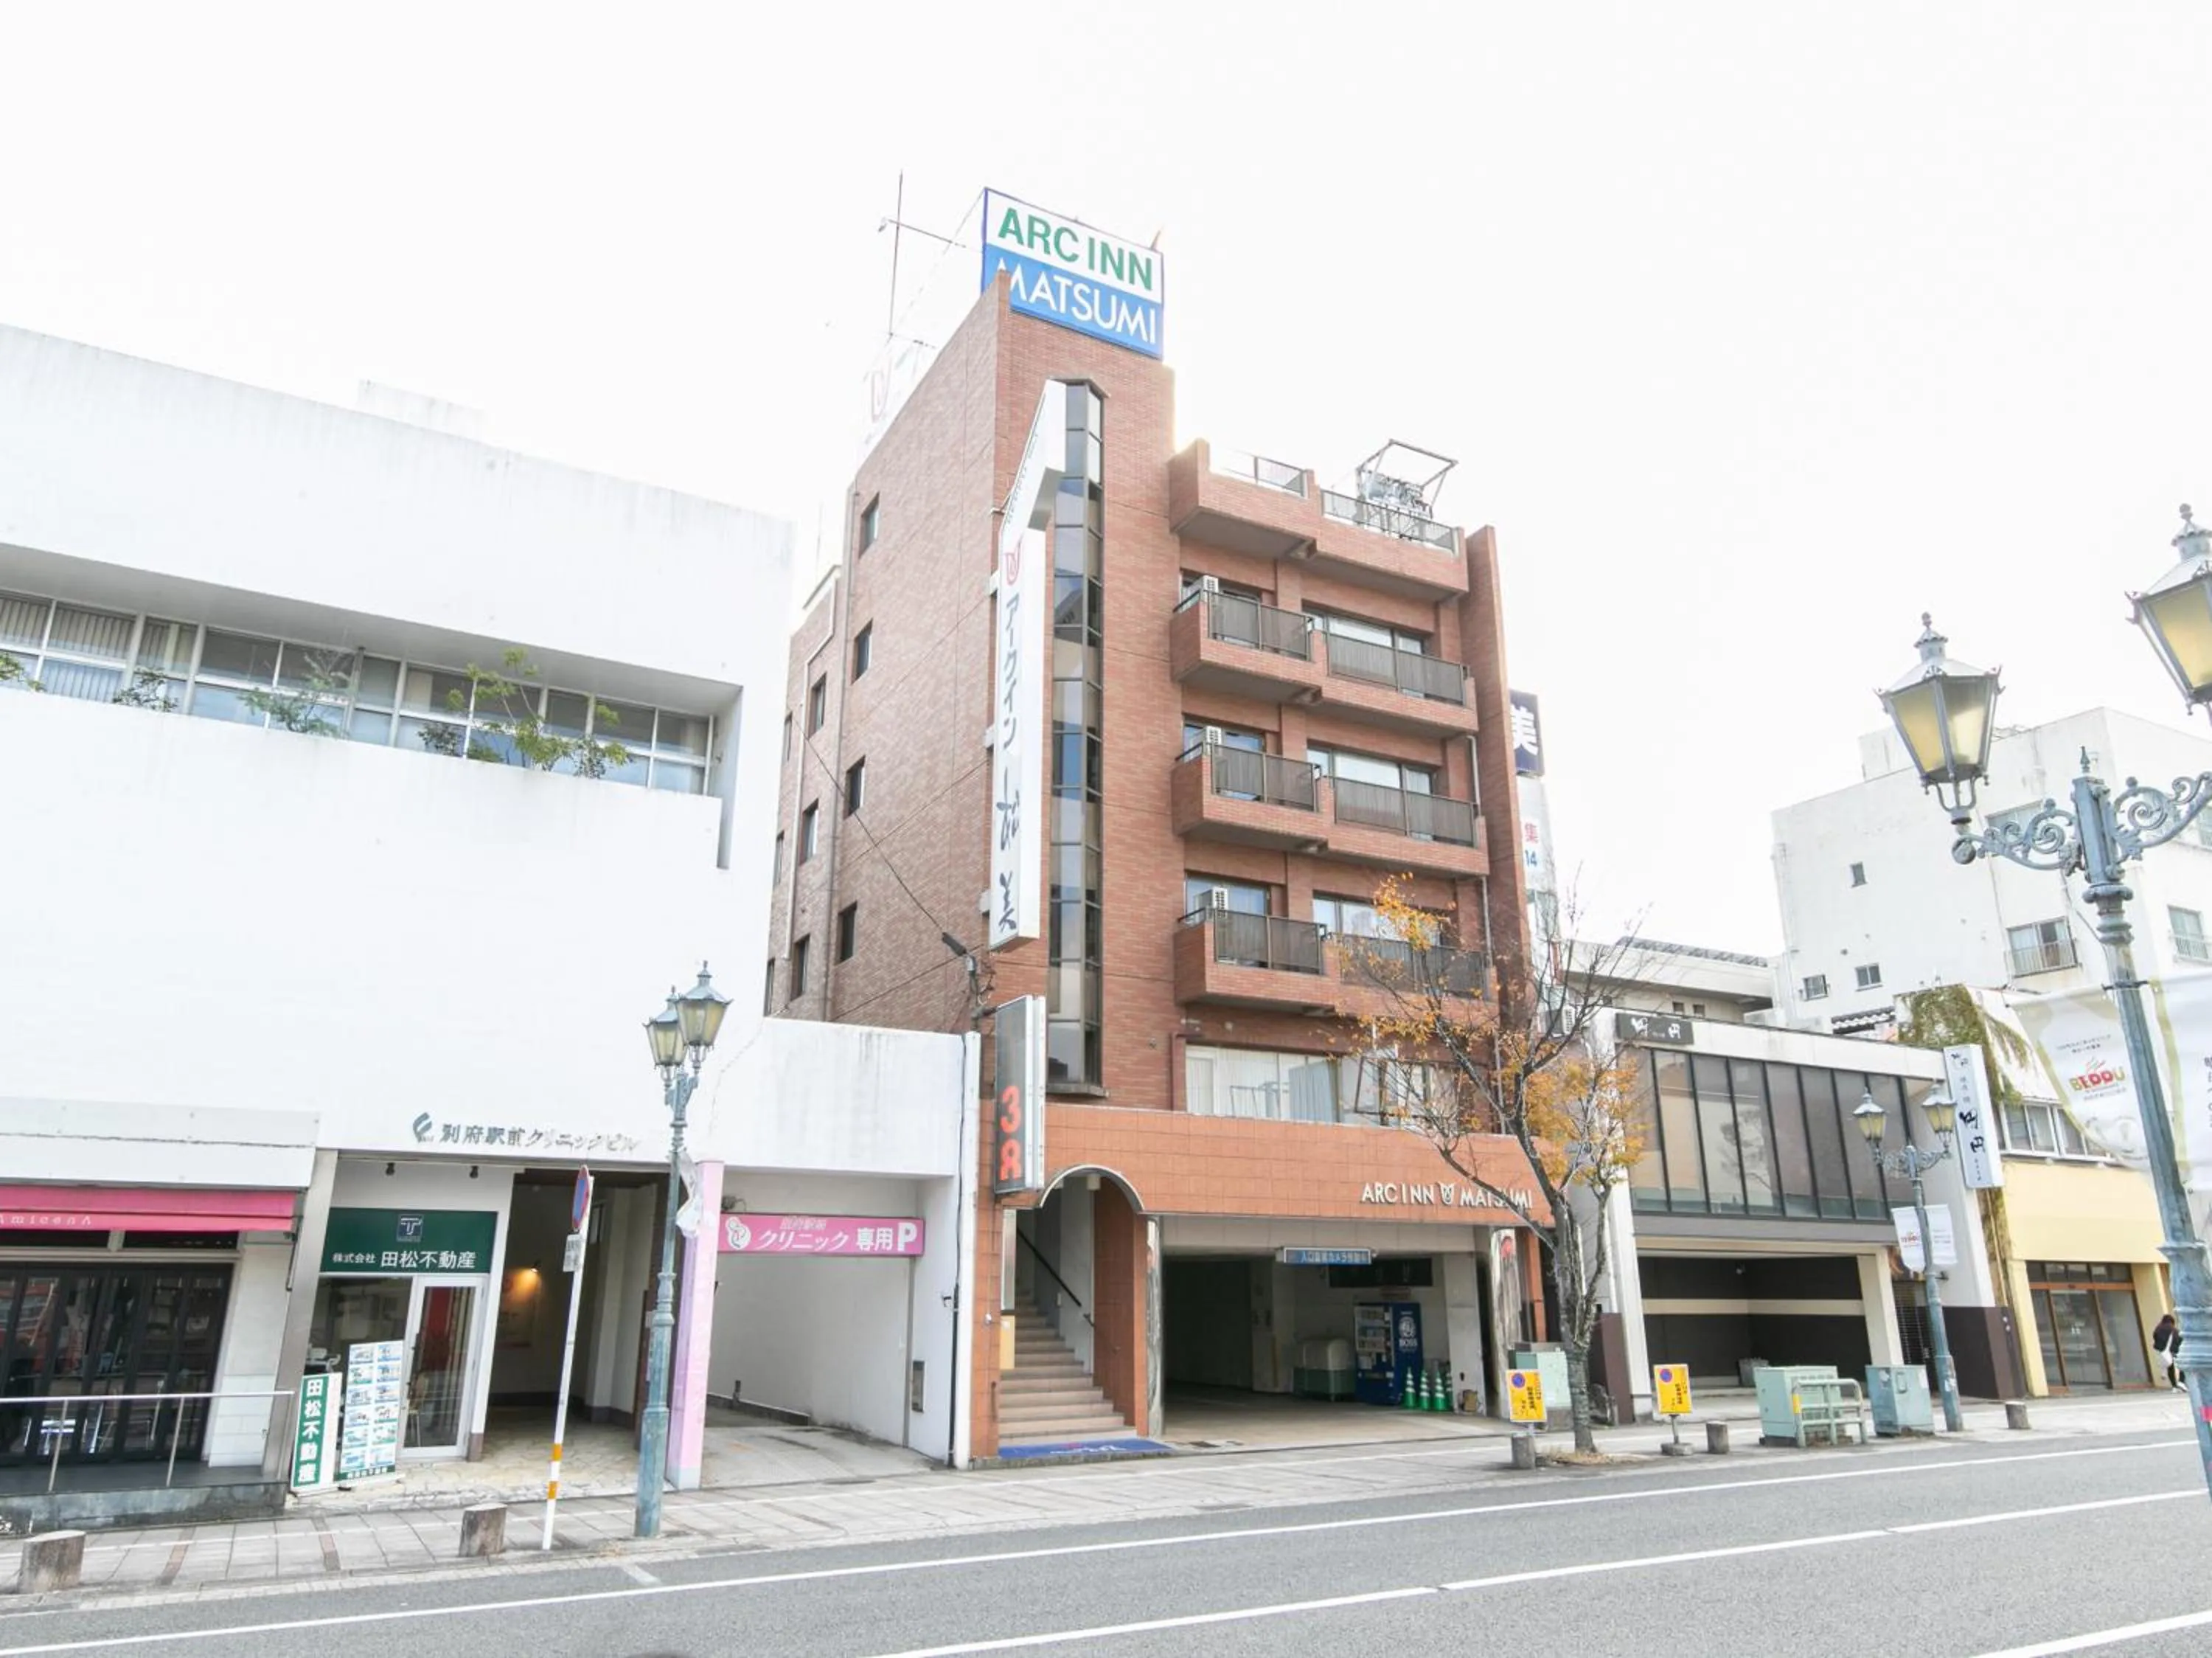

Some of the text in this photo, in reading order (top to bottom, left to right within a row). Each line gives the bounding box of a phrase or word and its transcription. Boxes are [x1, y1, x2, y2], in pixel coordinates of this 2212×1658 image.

[998, 207, 1152, 291] ARC INN
[997, 257, 1156, 344] MATSUMI
[1003, 592, 1020, 750] アークイン
[1361, 1181, 1399, 1204] ARC
[1401, 1182, 1436, 1205] INN
[333, 1250, 476, 1269] 株式会社 田松不動産
[754, 1229, 850, 1252] クリニック
